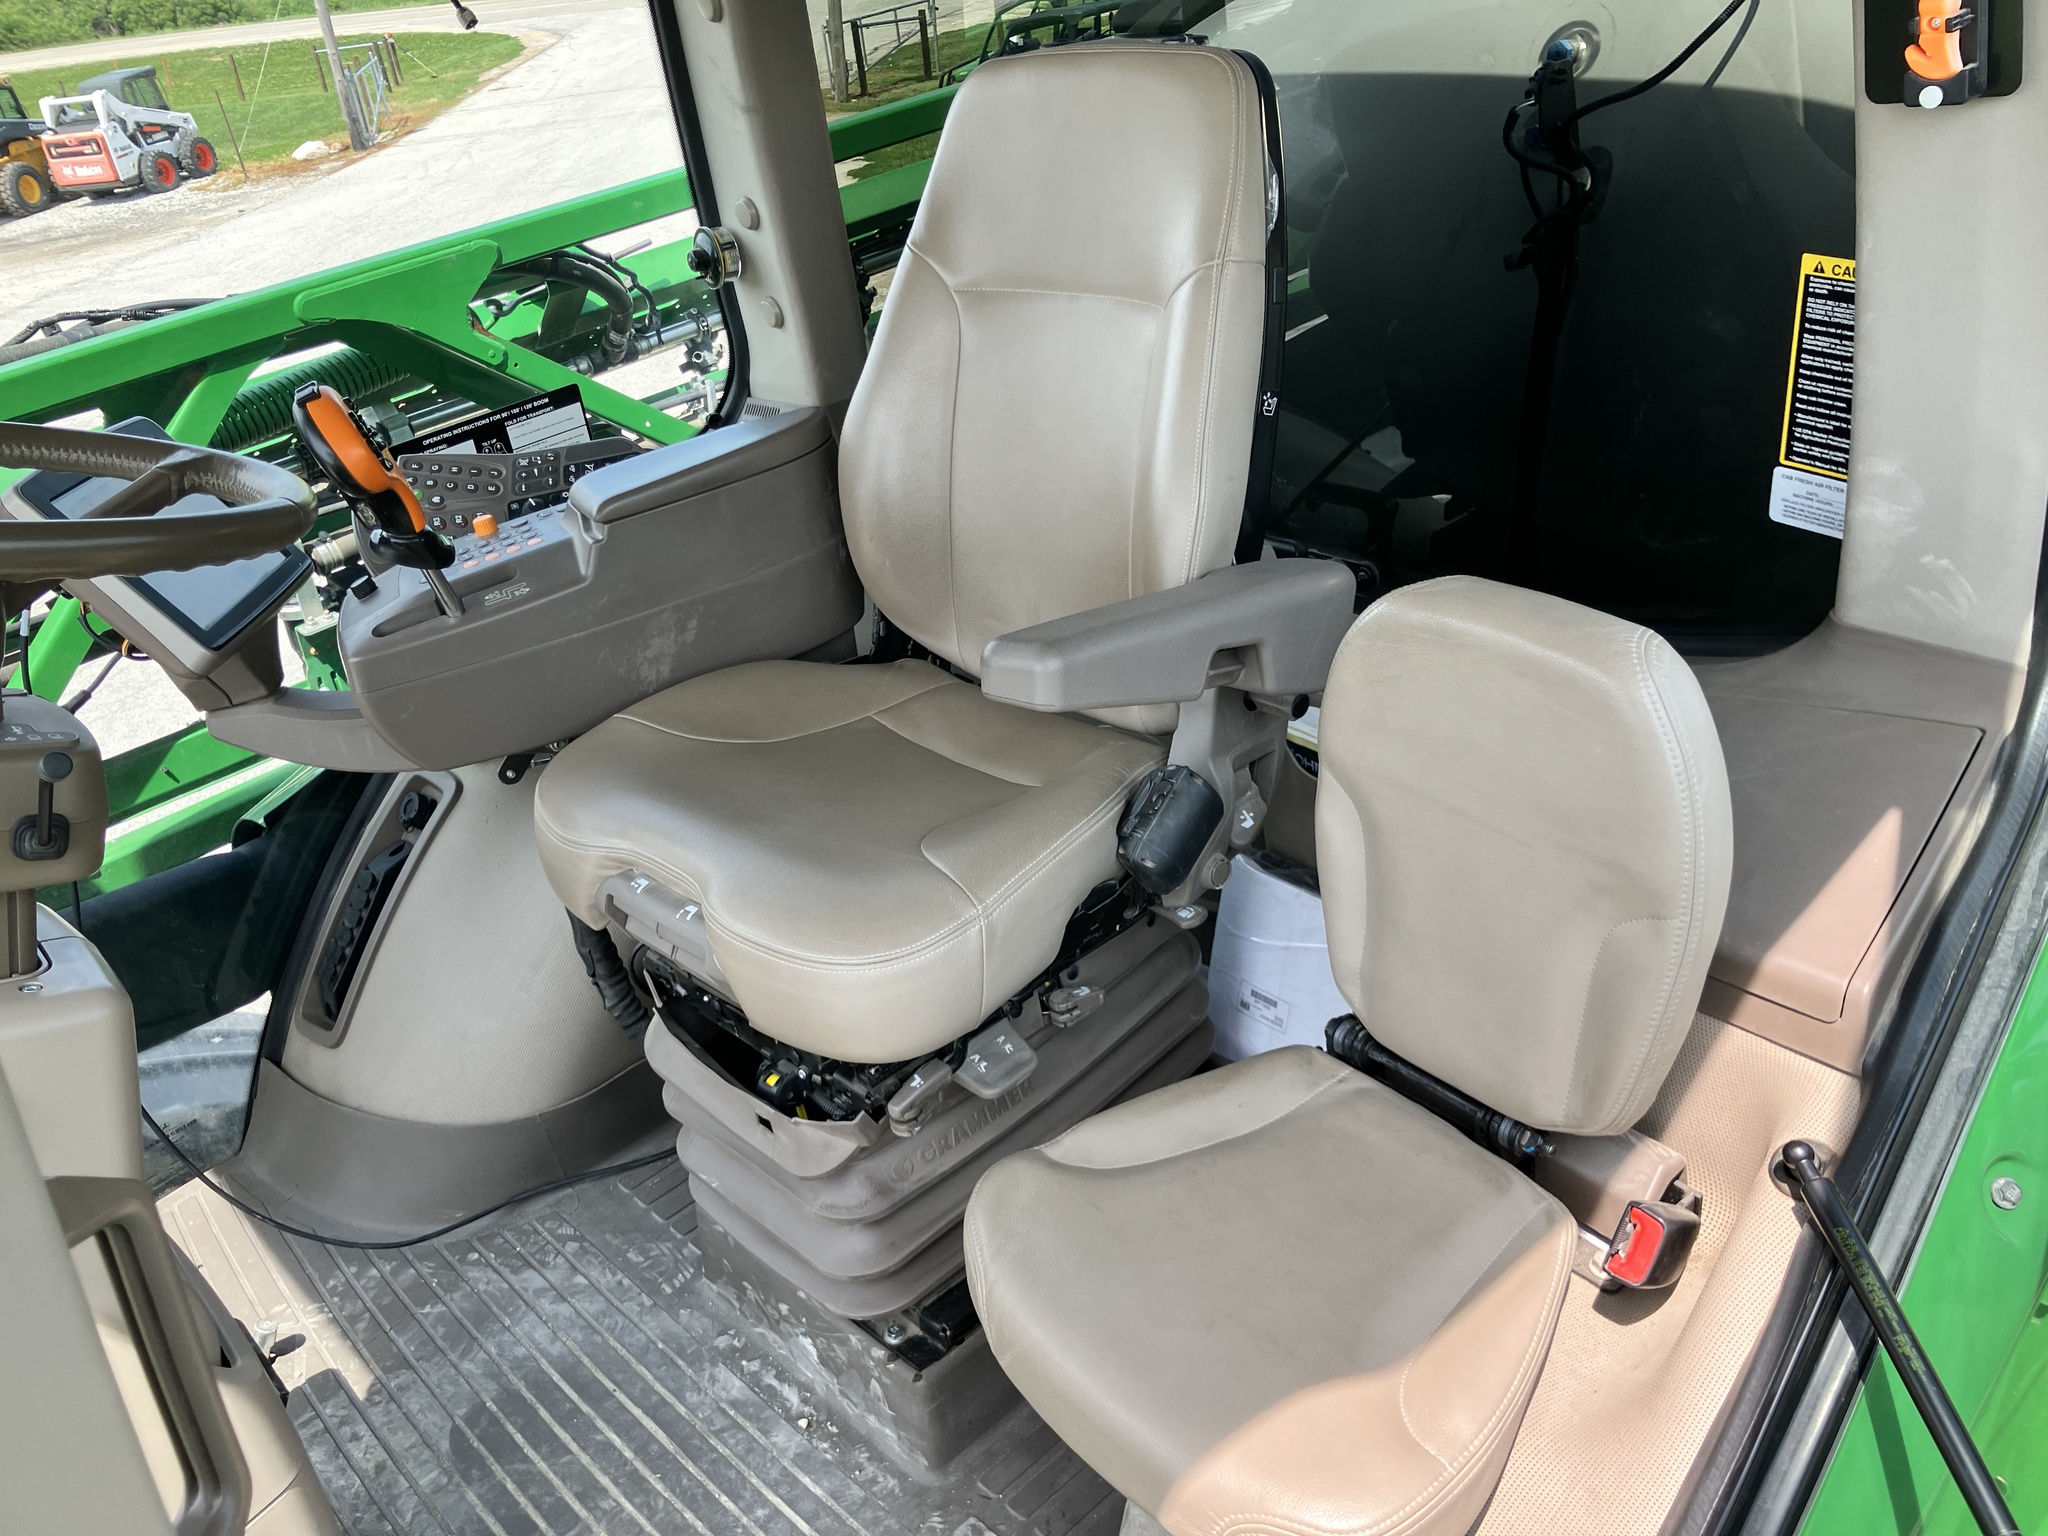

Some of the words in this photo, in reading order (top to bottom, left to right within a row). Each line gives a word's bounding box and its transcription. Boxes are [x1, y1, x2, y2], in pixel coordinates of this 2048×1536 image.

[73, 165, 103, 176] Bobcat
[1815, 336, 1841, 344] PERSONAL
[527, 406, 554, 418] TRANSPORT:
[421, 431, 453, 445] OPERATING
[452, 418, 489, 434] INSTRUCTIONS
[532, 397, 549, 406] BOOM
[1824, 485, 1844, 493] FILTER
[1792, 493, 1813, 501] MACHINE
[455, 515, 462, 523] R2
[918, 1078, 1034, 1164] GRAMMER
